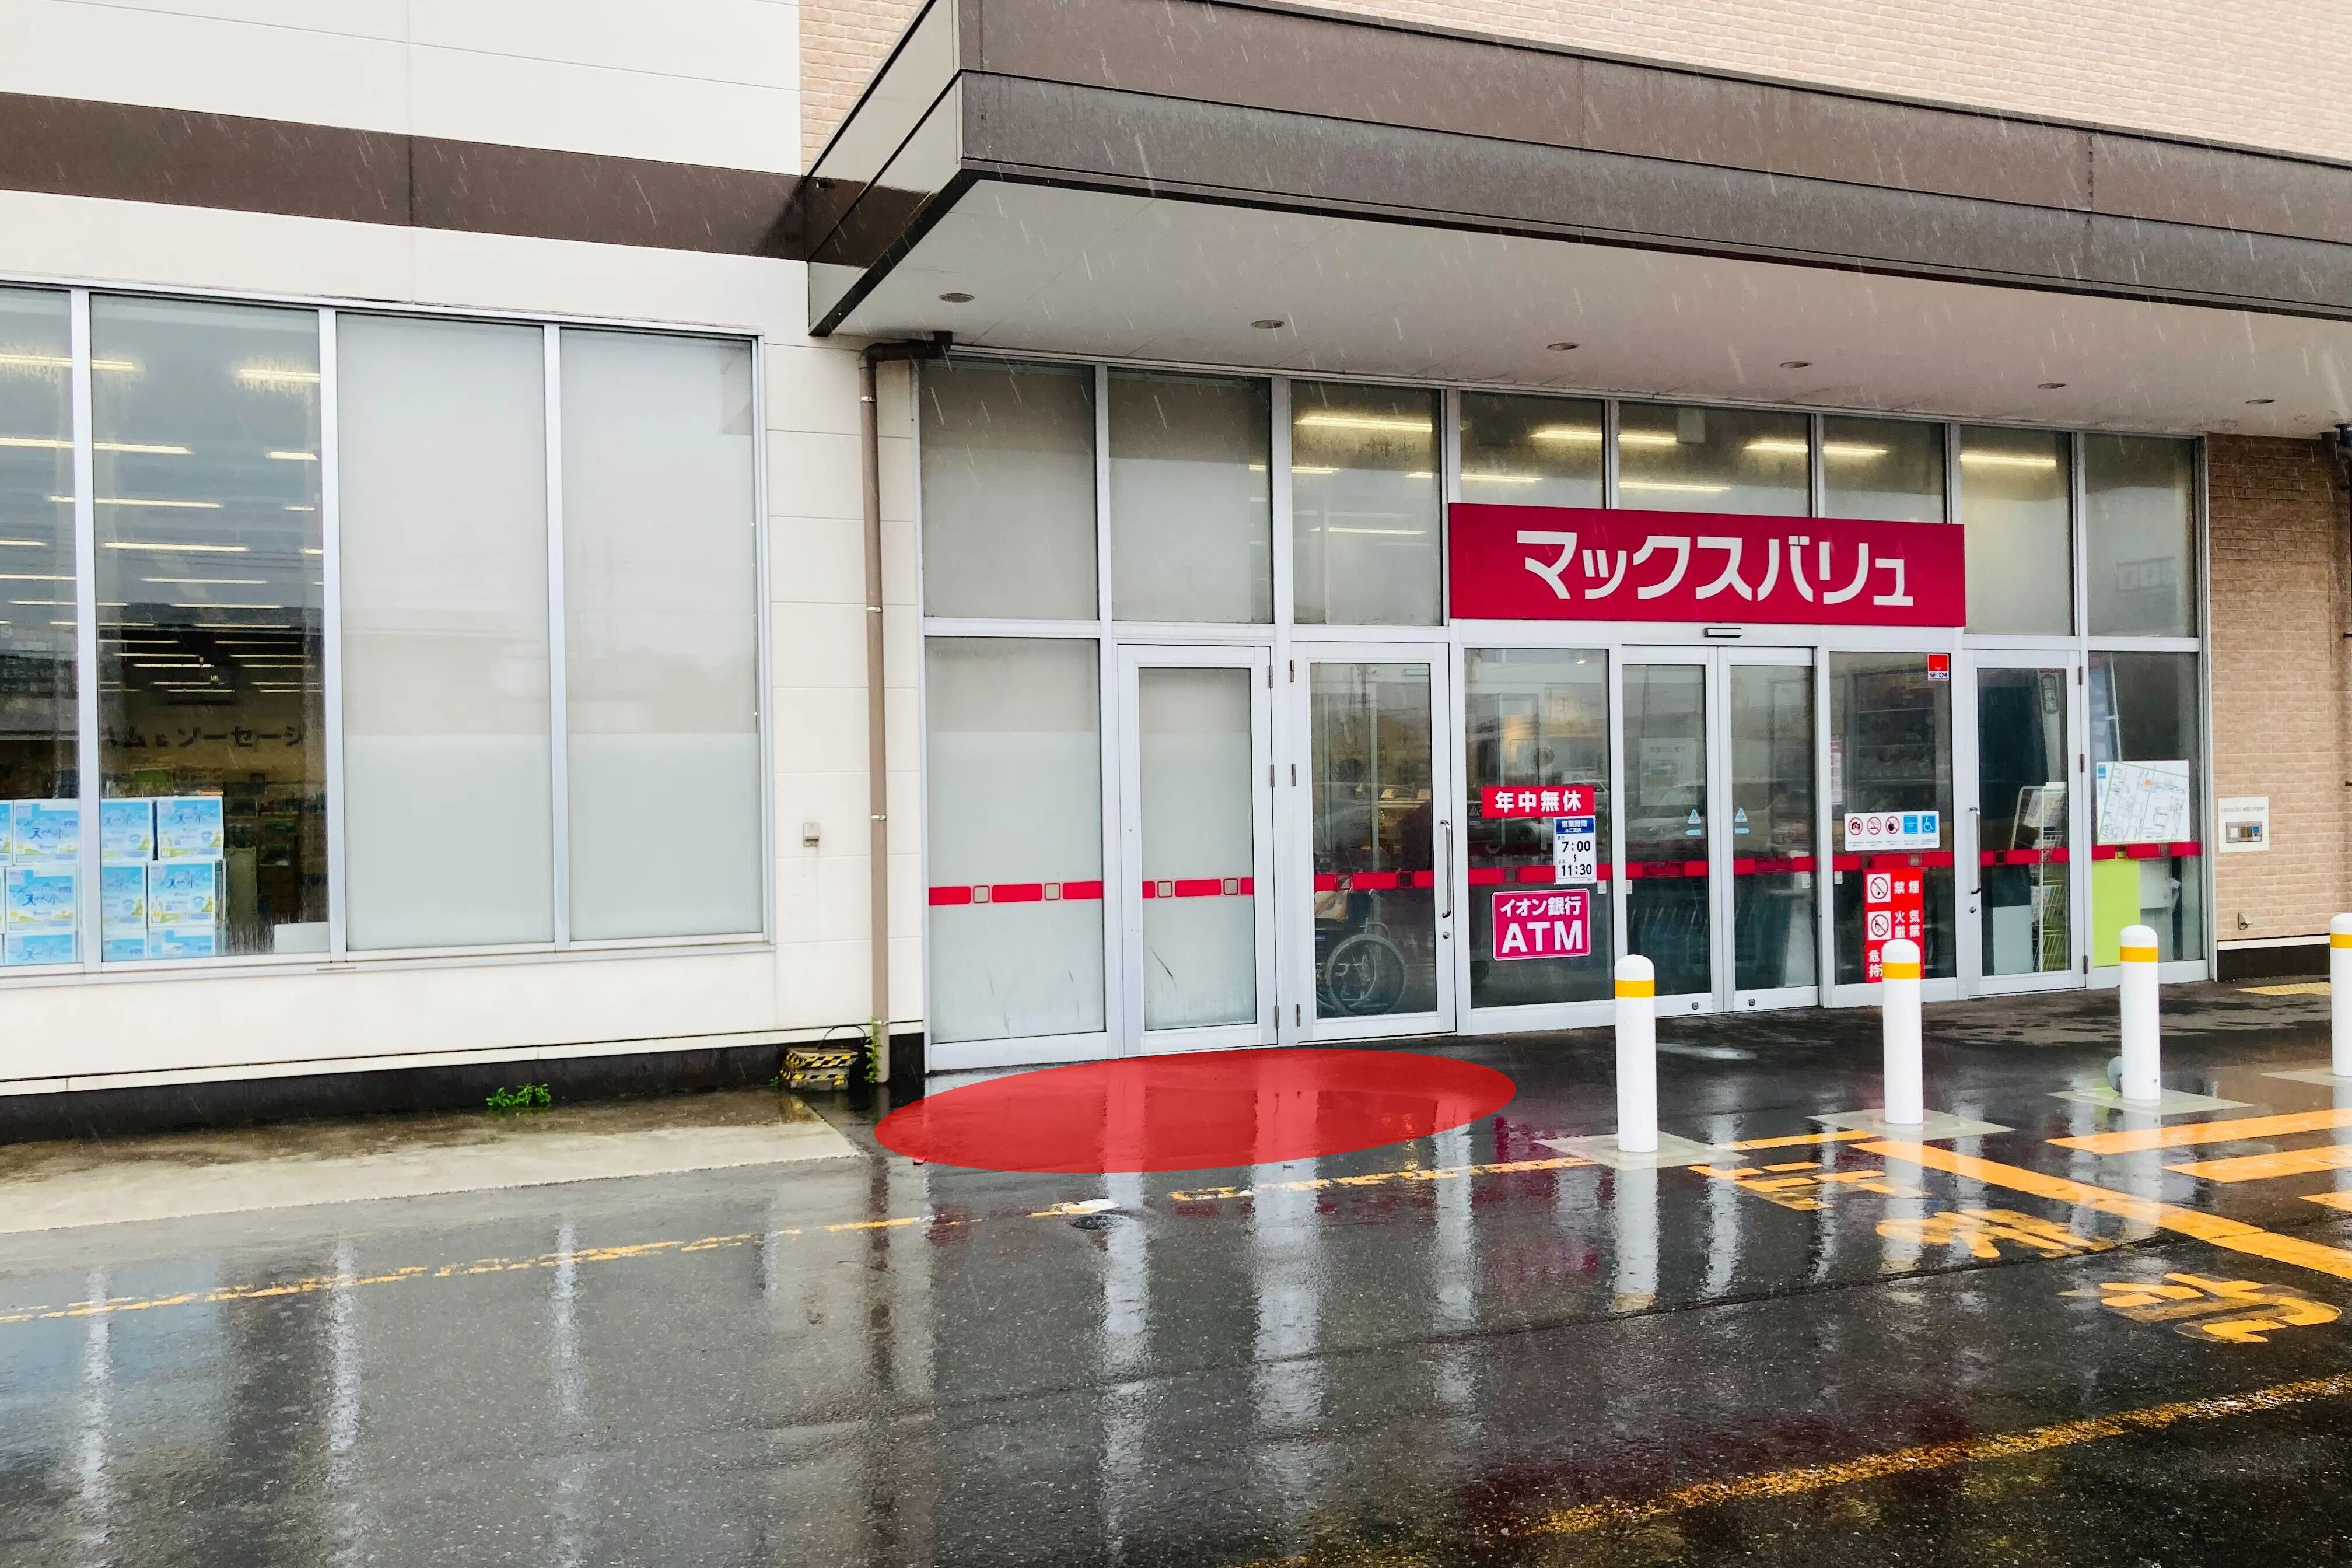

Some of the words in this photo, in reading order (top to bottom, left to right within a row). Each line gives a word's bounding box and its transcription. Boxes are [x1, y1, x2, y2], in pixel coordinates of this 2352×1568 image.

[1517, 530, 1914, 607] マックスバリュ
[1494, 790, 1582, 813] 年中無休
[1561, 840, 1591, 853] 7:00
[1562, 863, 1592, 876] 11:30
[1894, 880, 1920, 894] 禁煙
[1500, 895, 1581, 918] イオン銀行
[1894, 909, 1920, 923] 火気
[1501, 920, 1583, 954] ATM
